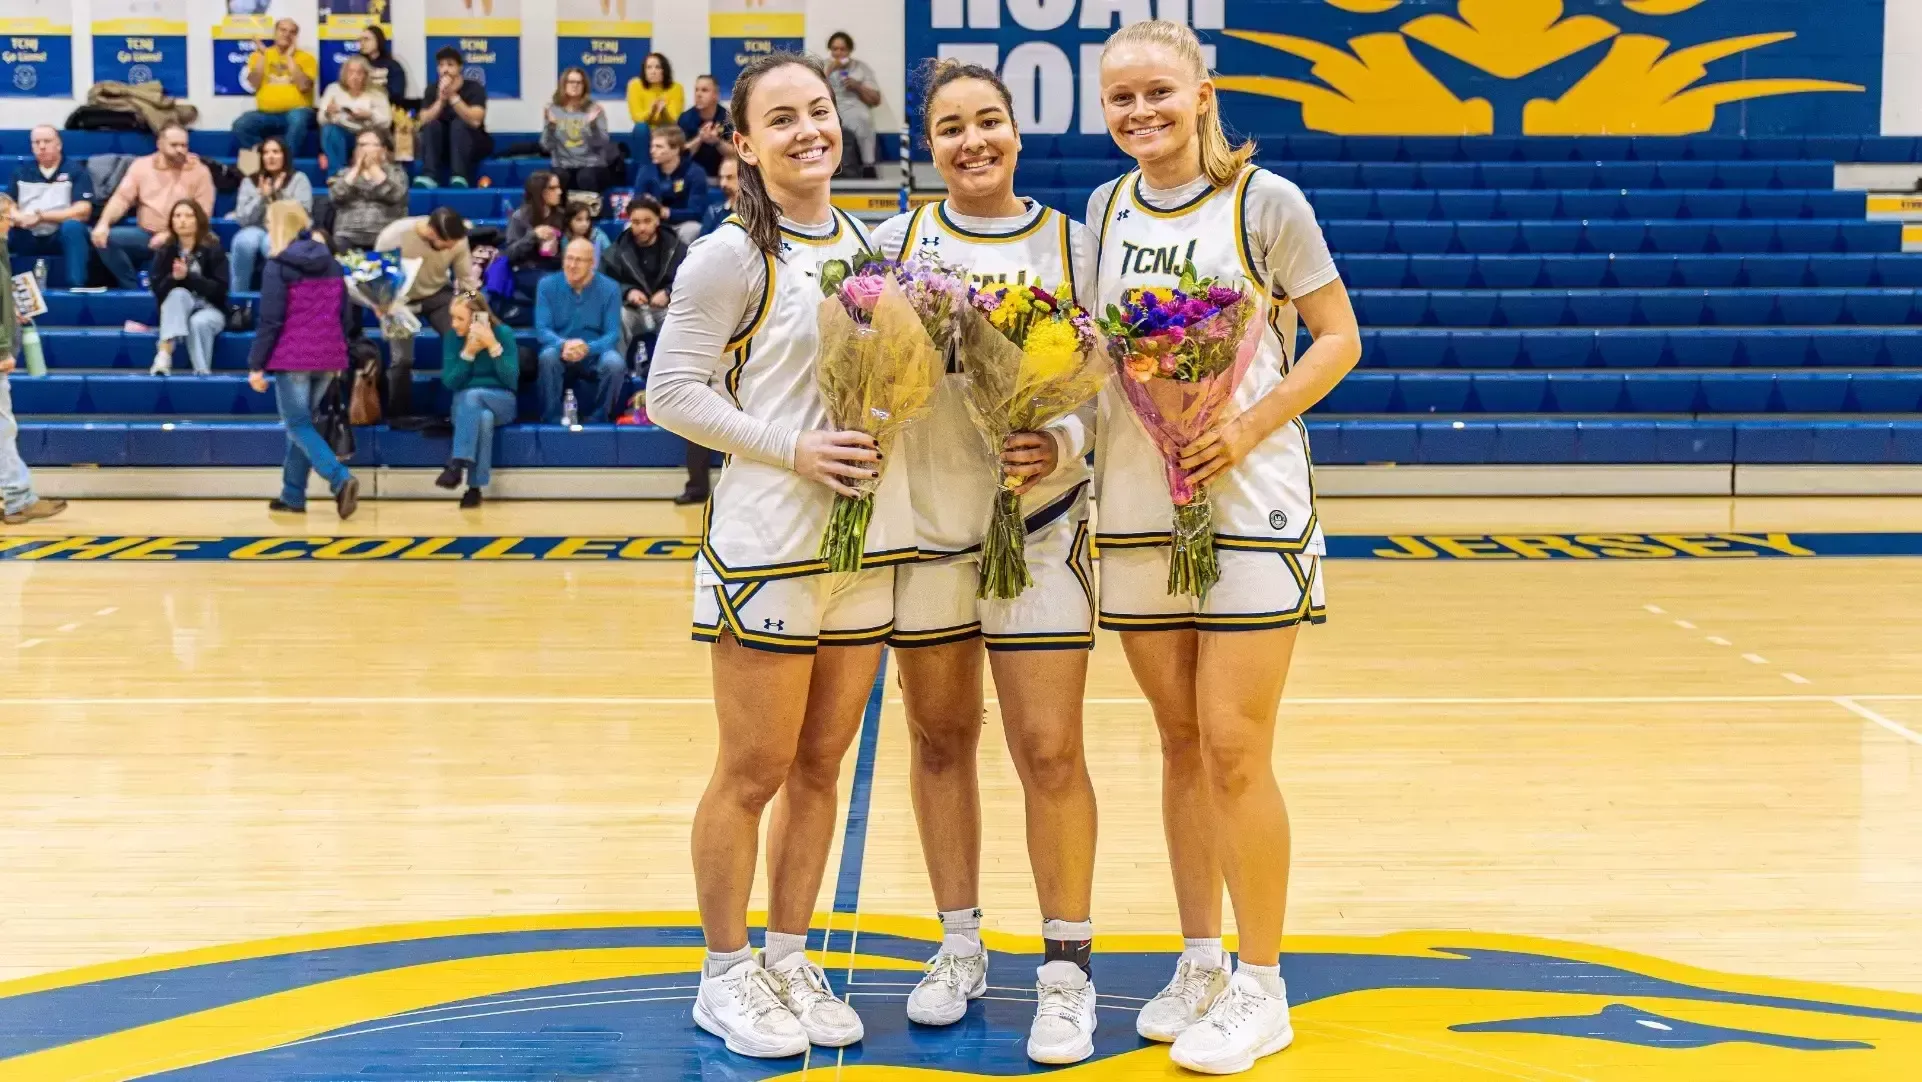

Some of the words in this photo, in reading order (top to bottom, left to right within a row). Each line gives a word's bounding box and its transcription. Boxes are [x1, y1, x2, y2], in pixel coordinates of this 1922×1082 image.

[1120, 238, 1197, 278] TCNJ
[0, 536, 224, 560] THE
[228, 536, 702, 560] COLLEG
[1373, 532, 1816, 559] JERSEY
